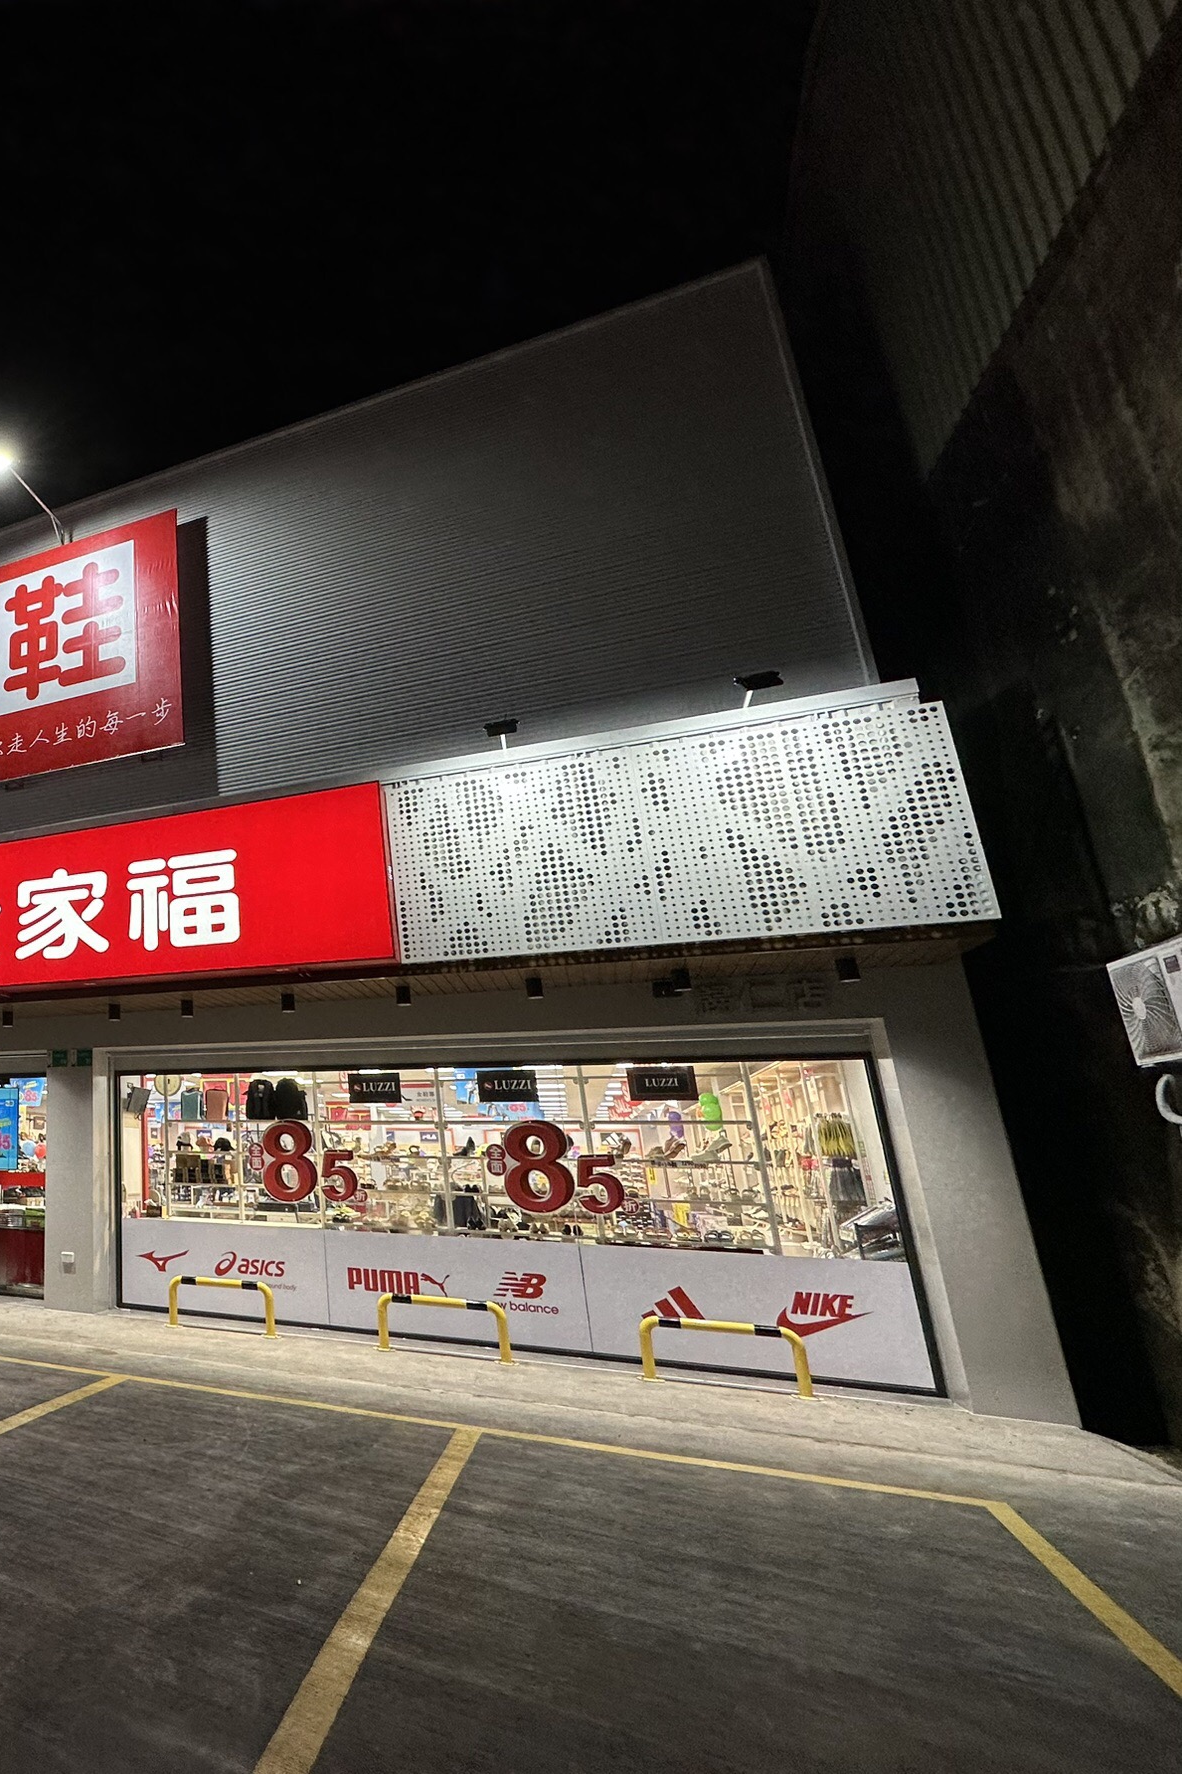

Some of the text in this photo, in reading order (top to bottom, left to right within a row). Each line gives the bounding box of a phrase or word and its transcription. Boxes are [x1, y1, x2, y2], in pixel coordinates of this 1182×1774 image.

[3, 561, 127, 701] 鞋
[362, 1081, 396, 1093] LUZZI
[494, 1079, 532, 1090] LUZZI
[644, 1077, 679, 1088] LUZZI
[237, 1258, 285, 1277] asics
[347, 1267, 420, 1295] PUMA
[509, 1301, 559, 1314] balance
[791, 1291, 854, 1317] NIKE
